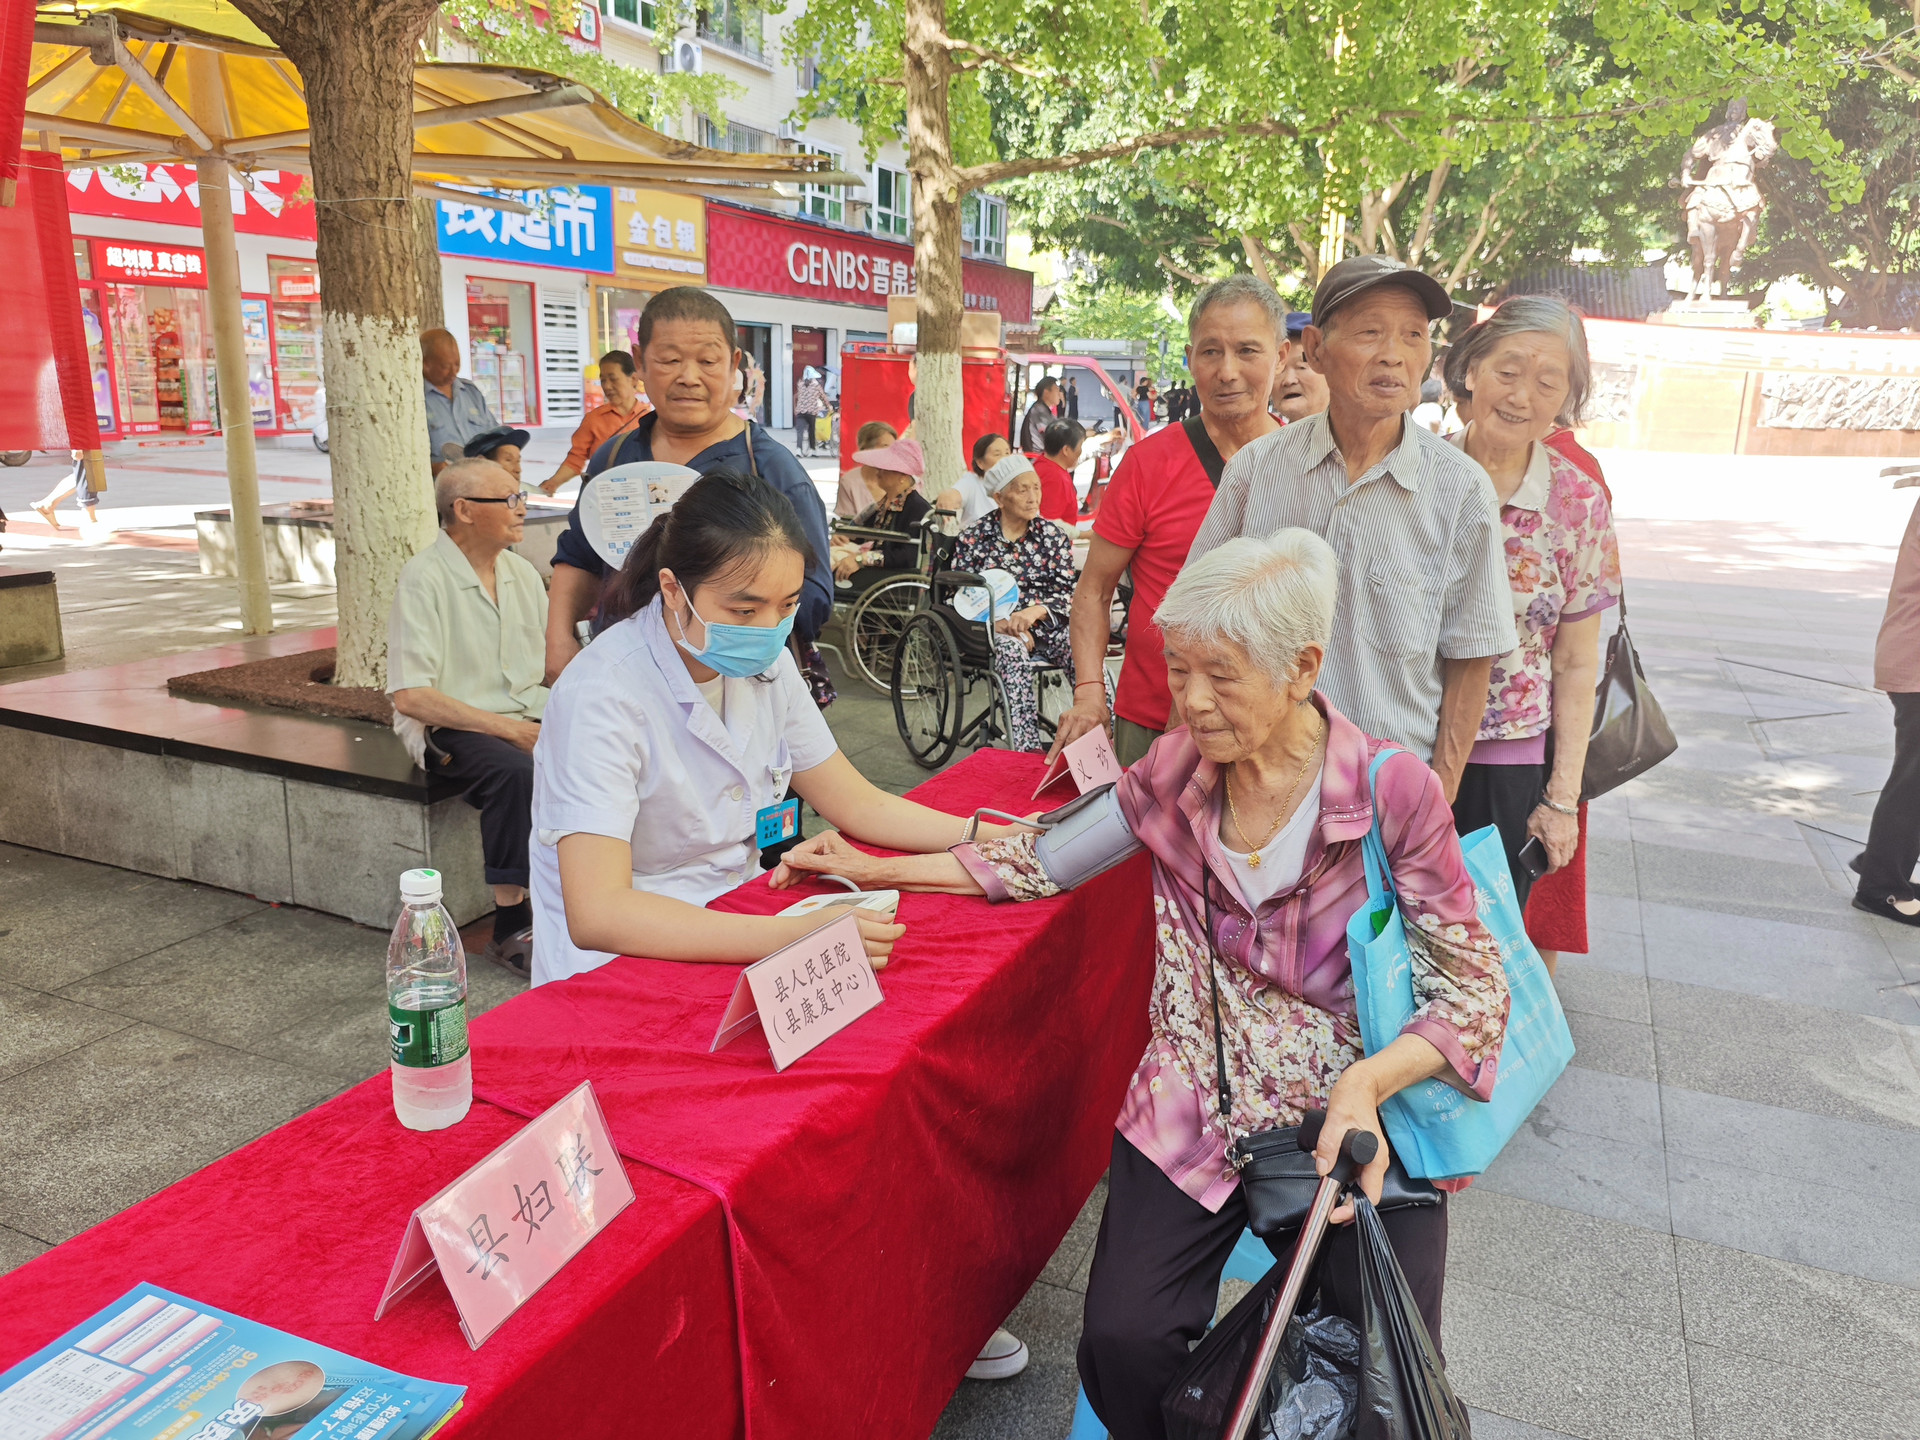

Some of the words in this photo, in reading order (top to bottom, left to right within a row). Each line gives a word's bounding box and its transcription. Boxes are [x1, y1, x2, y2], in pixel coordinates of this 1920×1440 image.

[627, 211, 697, 253] 金包银
[787, 241, 870, 292] GENBS
[1077, 744, 1109, 784] 义诊
[774, 941, 851, 1003] 县人民医院
[773, 962, 870, 1044] （县康复中心）
[466, 1133, 604, 1281] 县妇联
[187, 1399, 264, 1440] 免费
